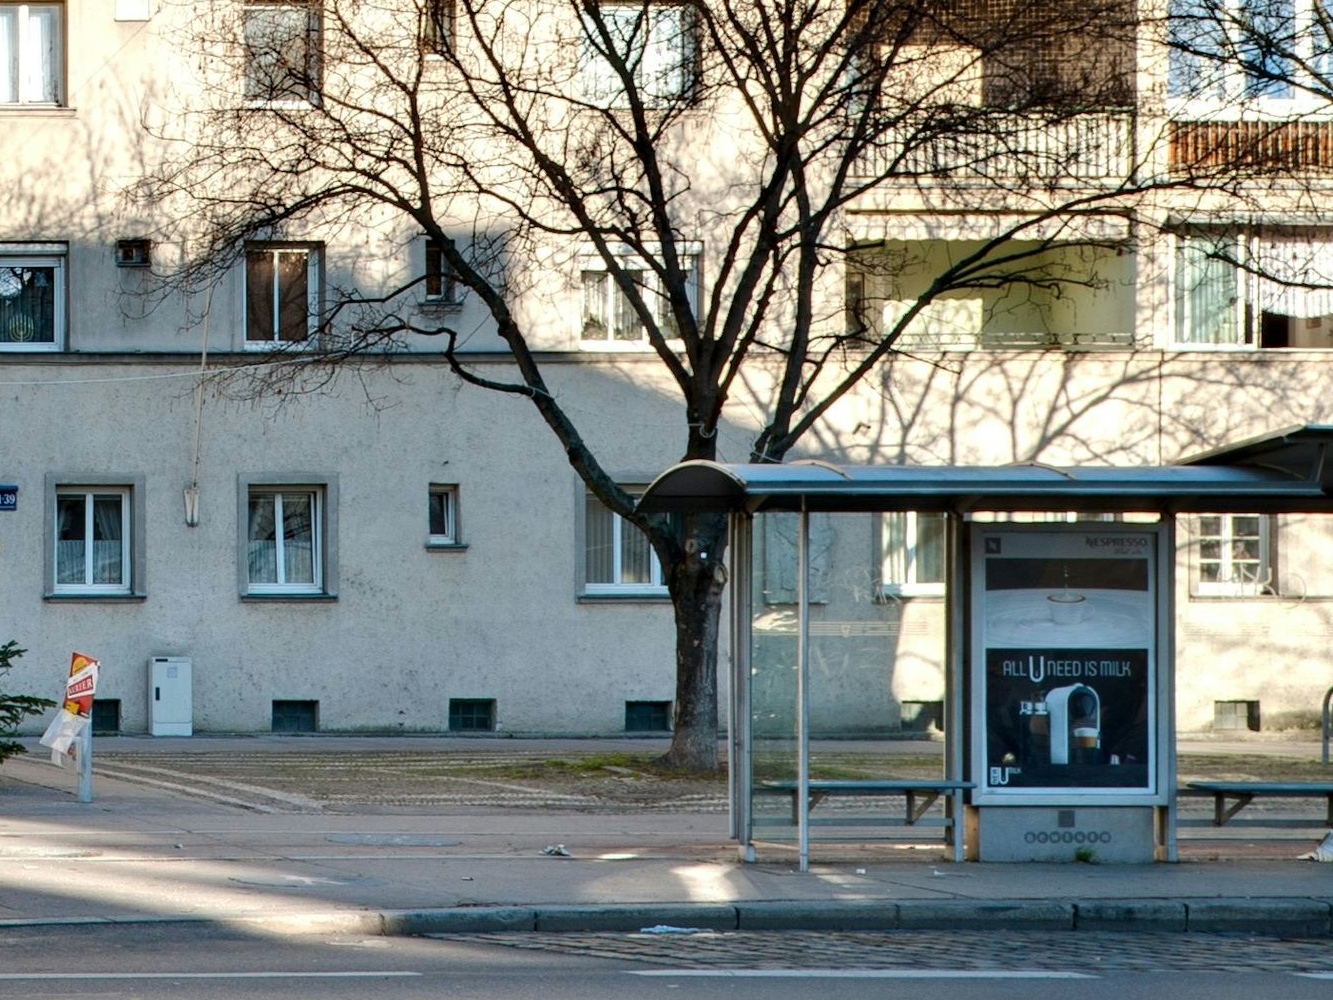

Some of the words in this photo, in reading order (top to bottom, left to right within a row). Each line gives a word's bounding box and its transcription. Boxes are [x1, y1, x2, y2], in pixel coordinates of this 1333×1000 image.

[1085, 535, 1148, 549] NESPRESSO
[1003, 660, 1027, 676] ALL
[1029, 655, 1044, 682] U
[1047, 660, 1081, 676] NEED
[1085, 660, 1097, 676] IS
[1100, 660, 1131, 676] MILK
